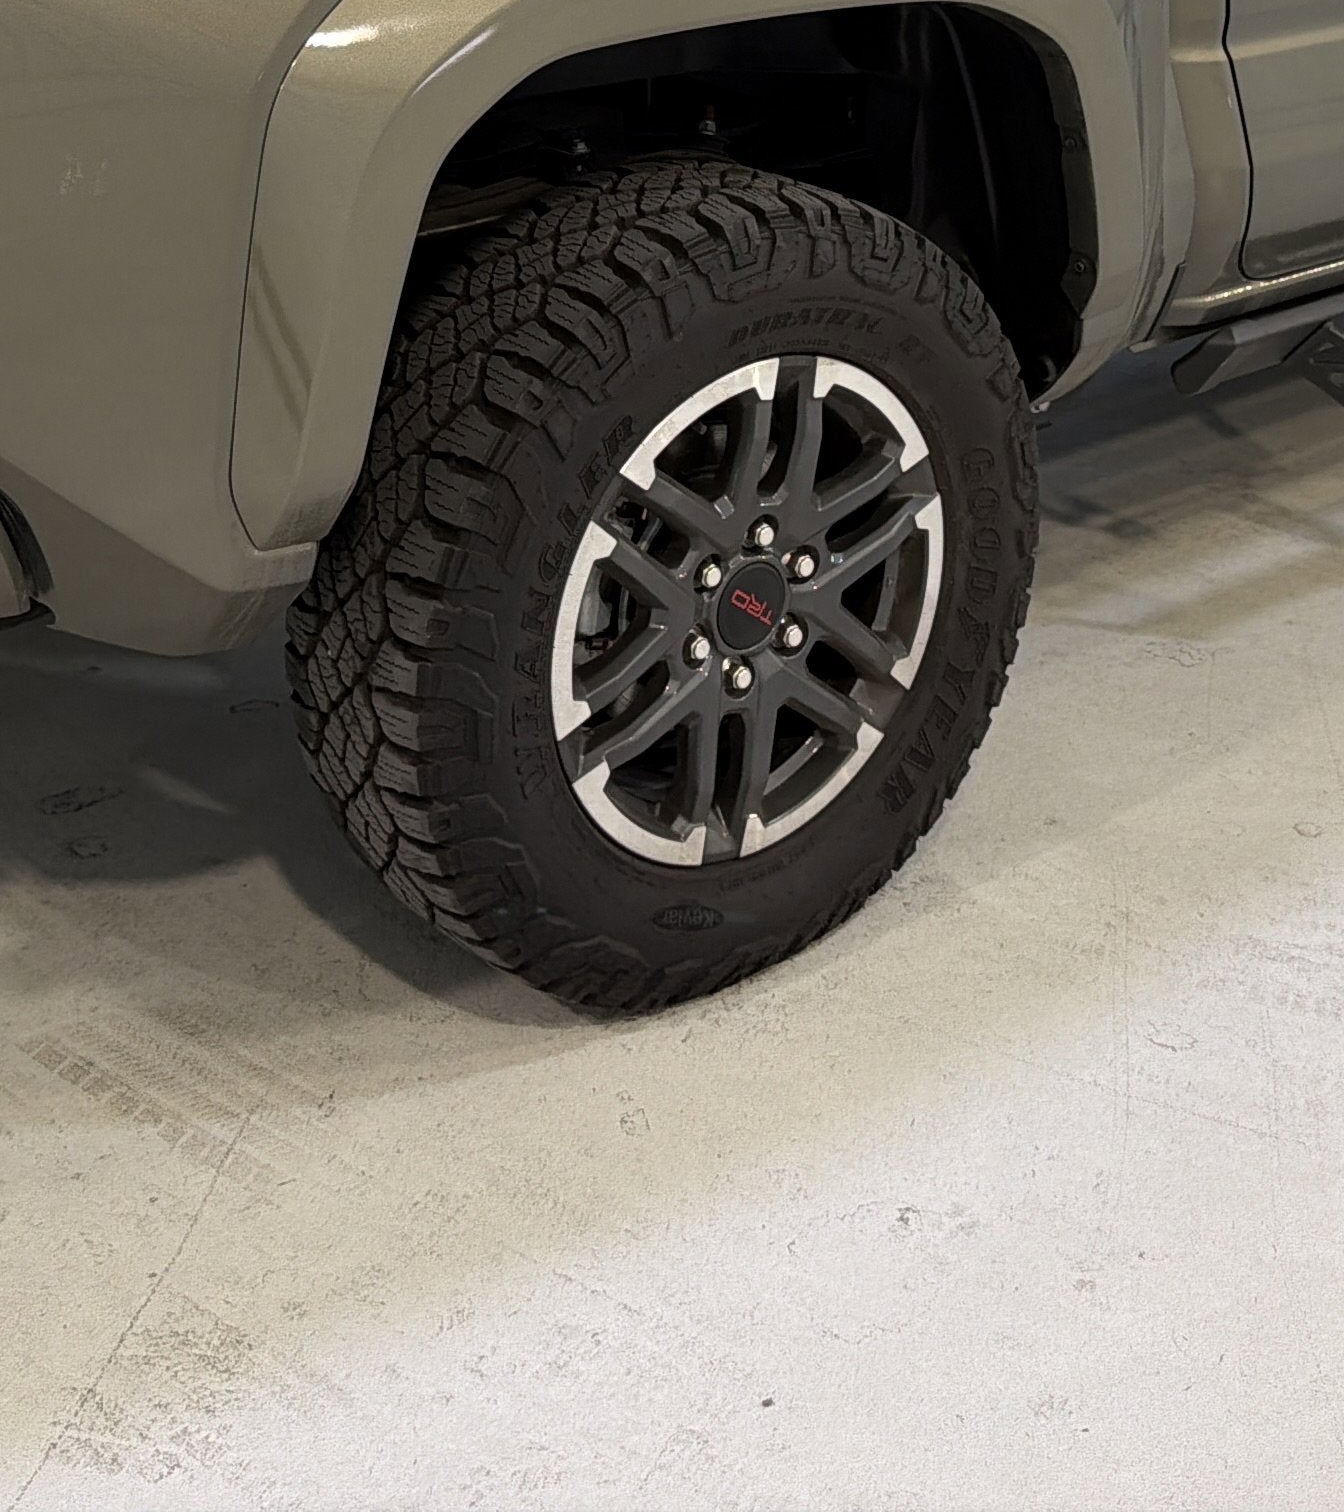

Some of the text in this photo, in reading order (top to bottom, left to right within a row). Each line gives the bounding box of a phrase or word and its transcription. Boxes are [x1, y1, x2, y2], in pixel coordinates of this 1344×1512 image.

[510, 414, 635, 801] WRANGLER
[731, 589, 772, 626] TRD
[875, 445, 1003, 817] GOODYEAR
